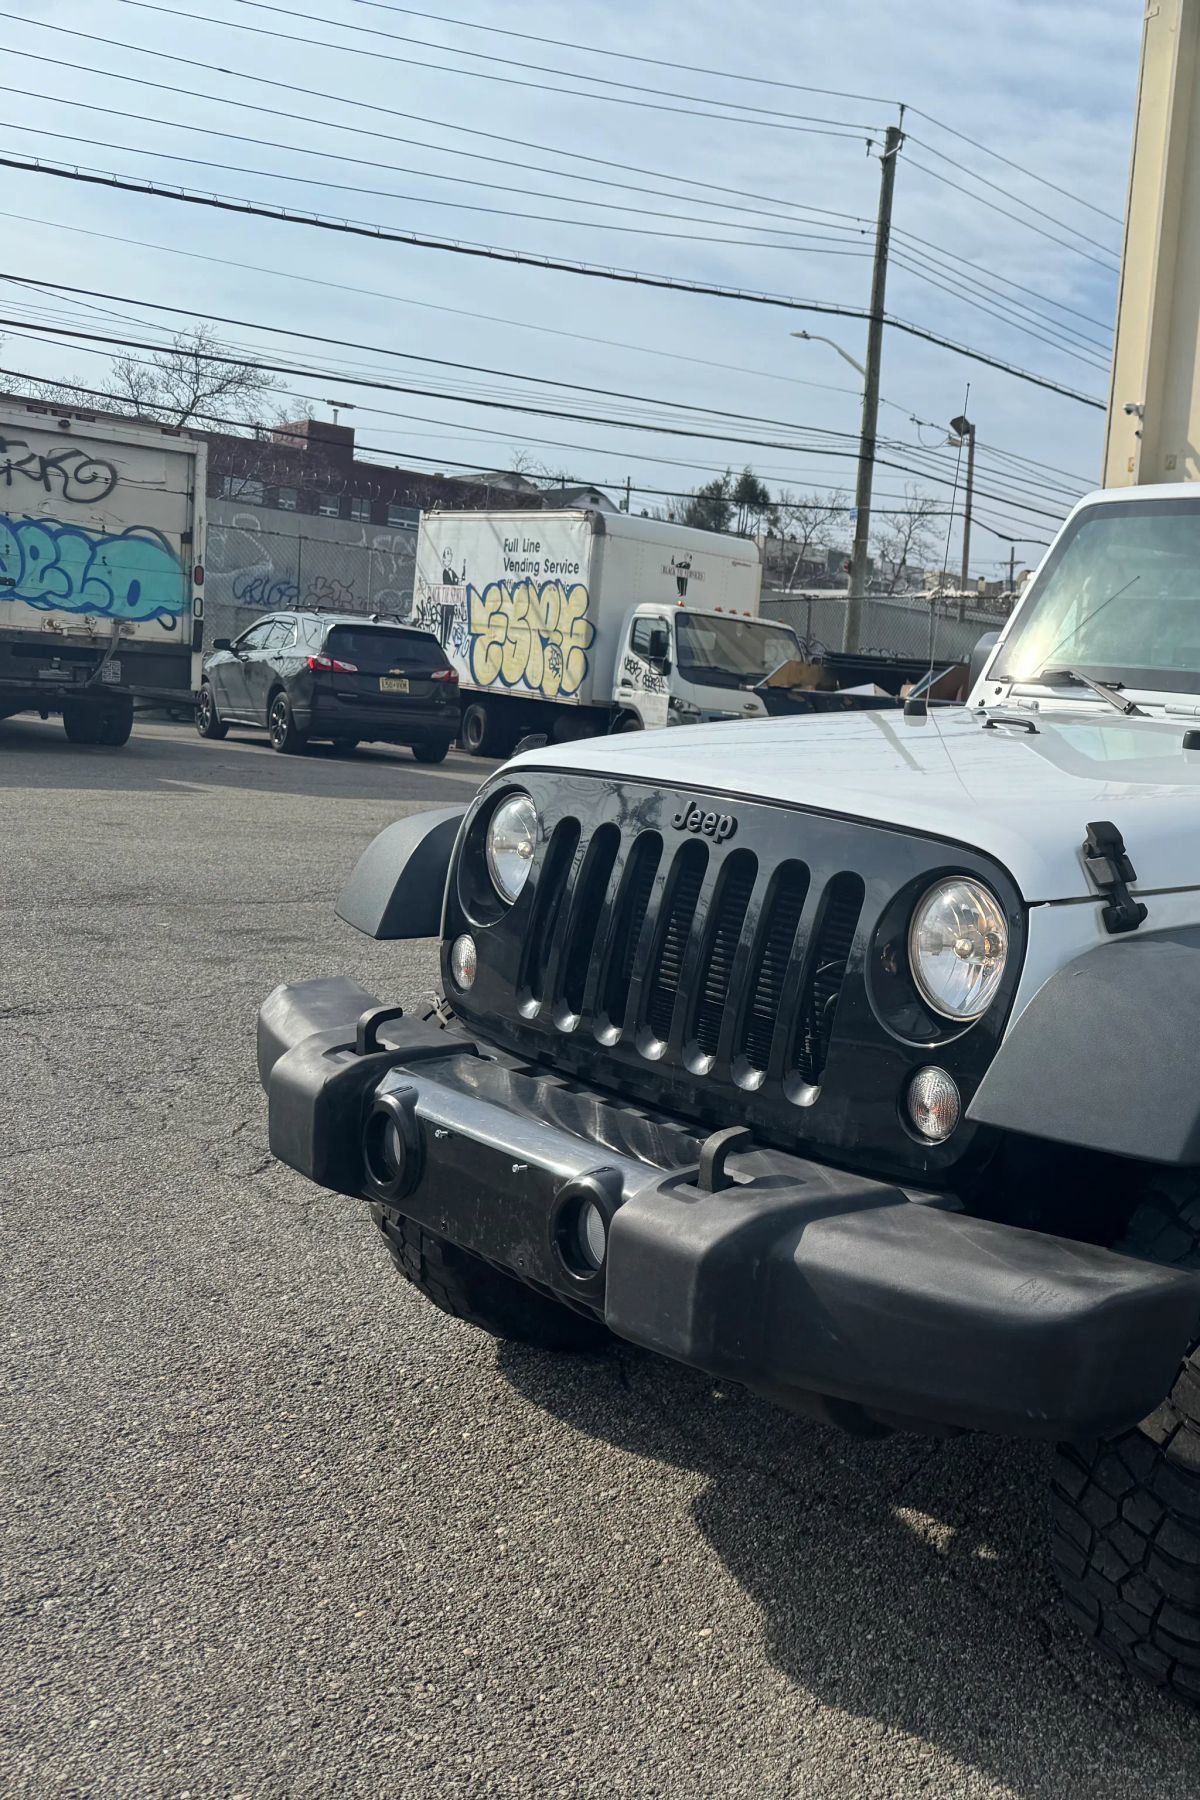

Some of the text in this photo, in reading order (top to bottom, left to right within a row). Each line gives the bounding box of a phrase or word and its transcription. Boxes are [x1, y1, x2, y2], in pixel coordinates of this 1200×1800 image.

[503, 538, 541, 553] Full Line
[503, 557, 580, 578] Vending Service
[671, 800, 738, 844] Jeep
